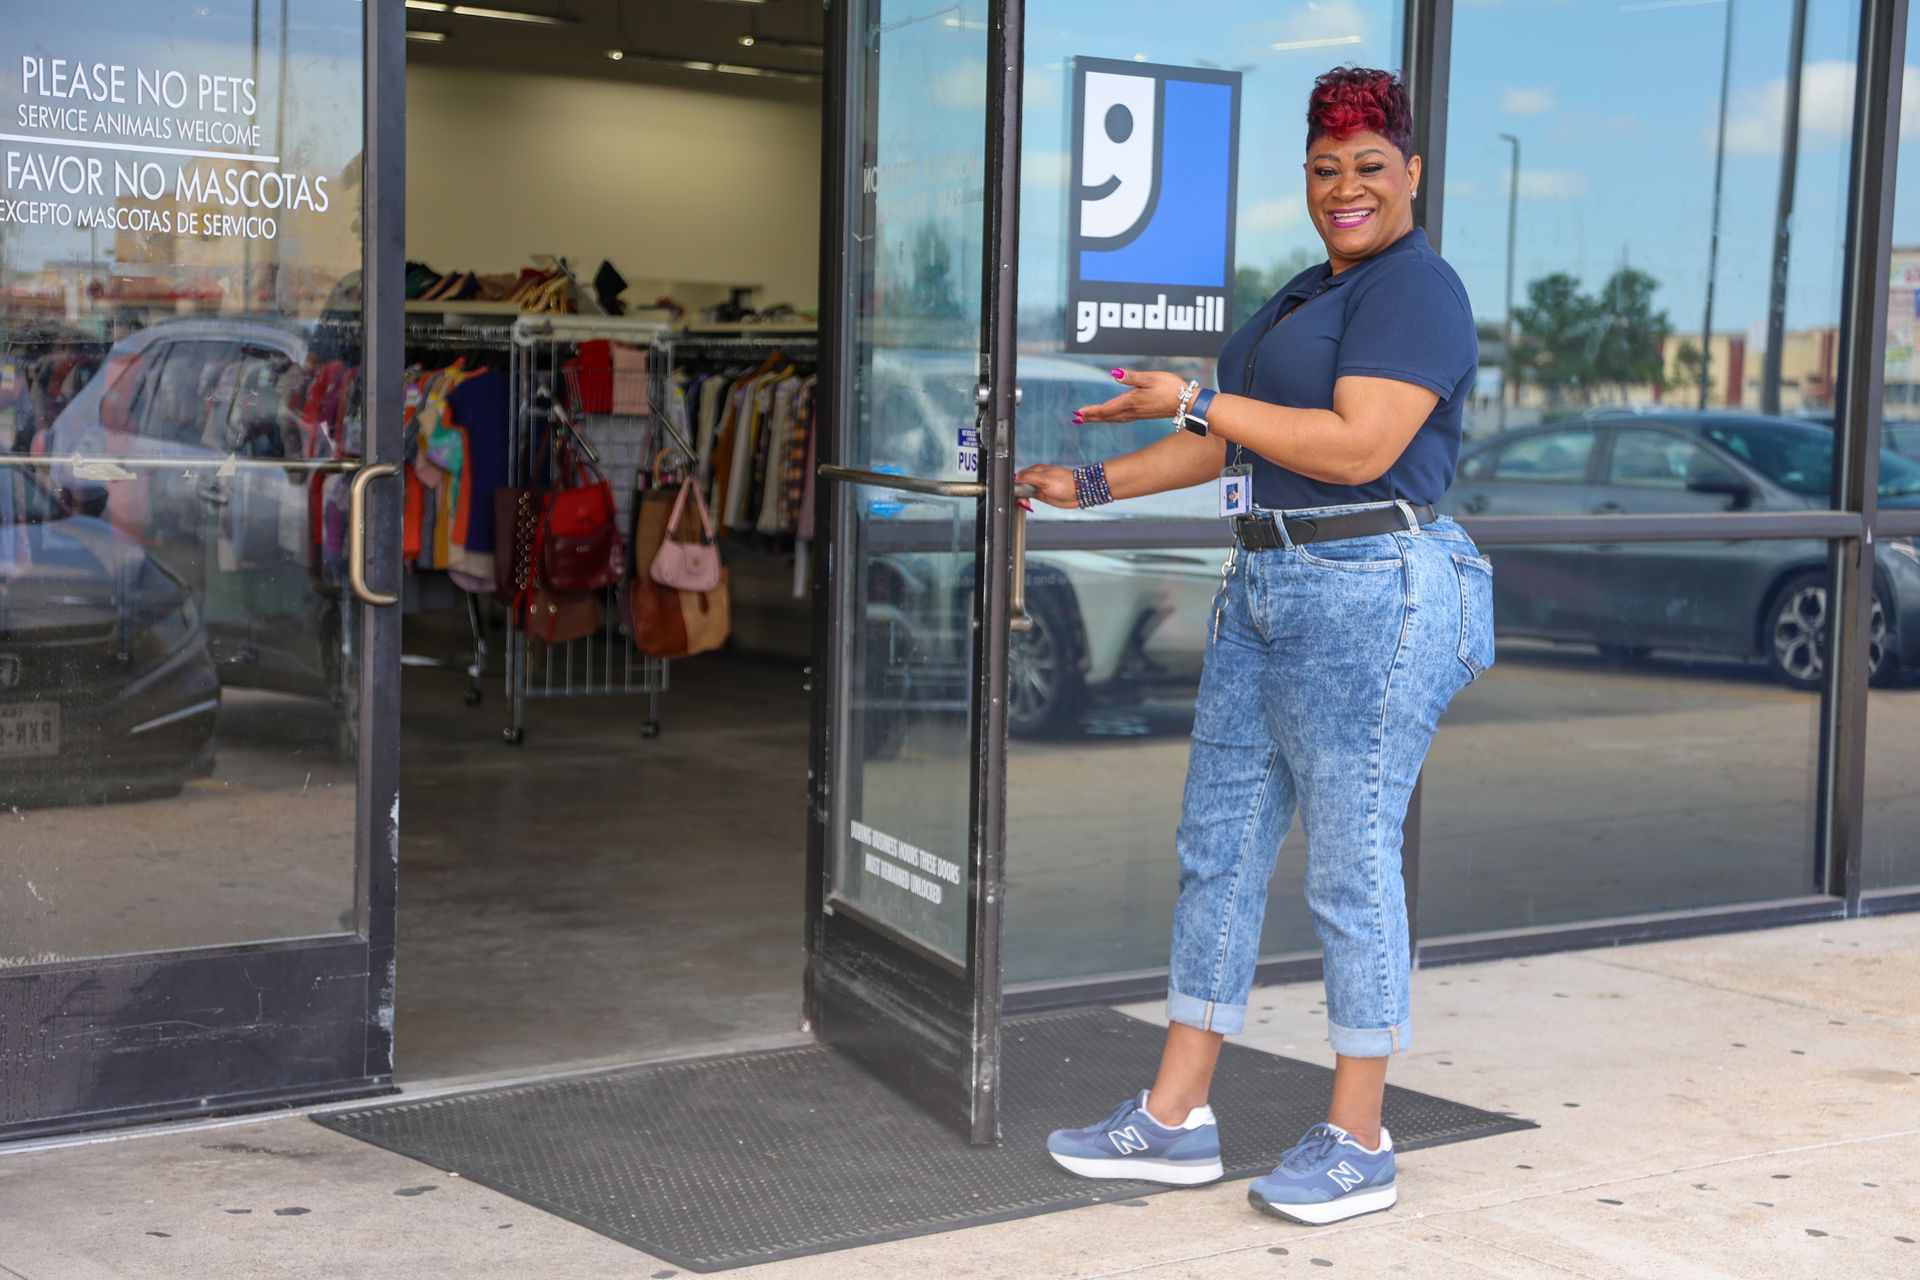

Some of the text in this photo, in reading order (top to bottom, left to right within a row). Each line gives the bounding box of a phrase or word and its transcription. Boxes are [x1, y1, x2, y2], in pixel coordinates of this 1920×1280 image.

[22, 55, 256, 116] PLEASE NO PETS
[17, 104, 261, 147] SERVICE ANIMALS WELCOME
[6, 151, 329, 213] FAVOR NO MASCOTAS
[77, 205, 171, 234] MASCOTAS
[177, 211, 198, 235] DE
[203, 213, 277, 240] SERVICIO
[1076, 294, 1225, 343] goodwill
[958, 451, 977, 472] PUS
[851, 820, 961, 886] DURING BUSINESS HOURS THESE DOORS
[865, 852, 880, 877] MUST
[910, 872, 942, 905] UNLOCKED
